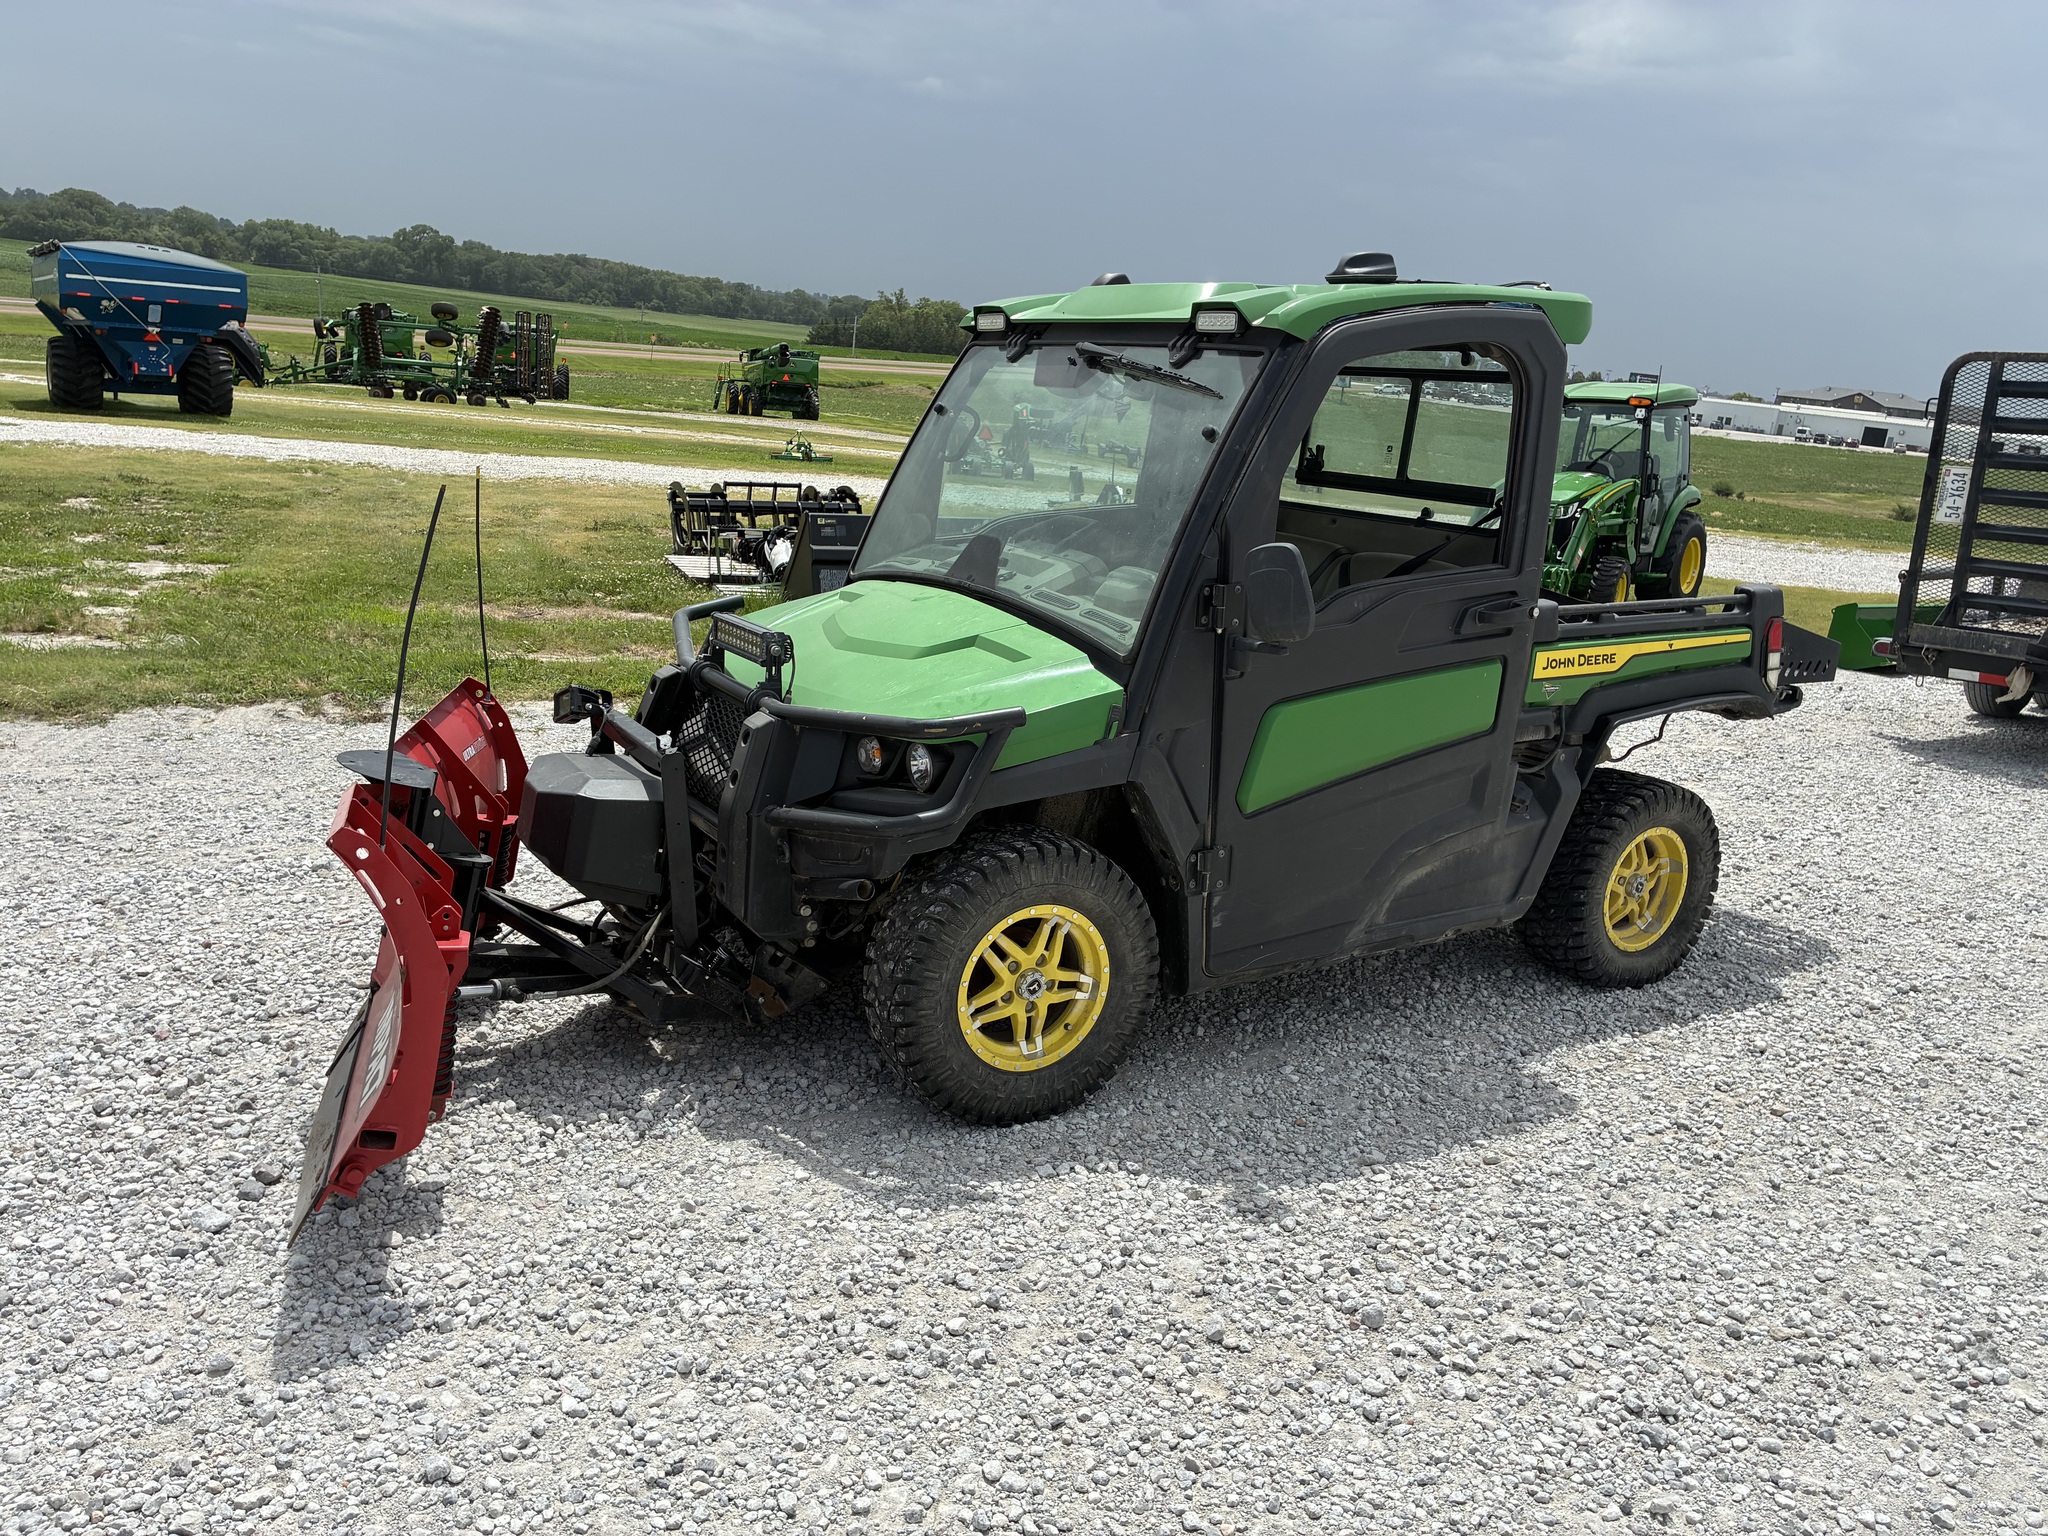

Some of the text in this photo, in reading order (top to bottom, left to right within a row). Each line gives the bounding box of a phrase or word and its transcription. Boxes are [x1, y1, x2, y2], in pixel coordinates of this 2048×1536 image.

[1945, 472, 1969, 519] 54-X634
[1542, 652, 1617, 670] JOHN DEERE
